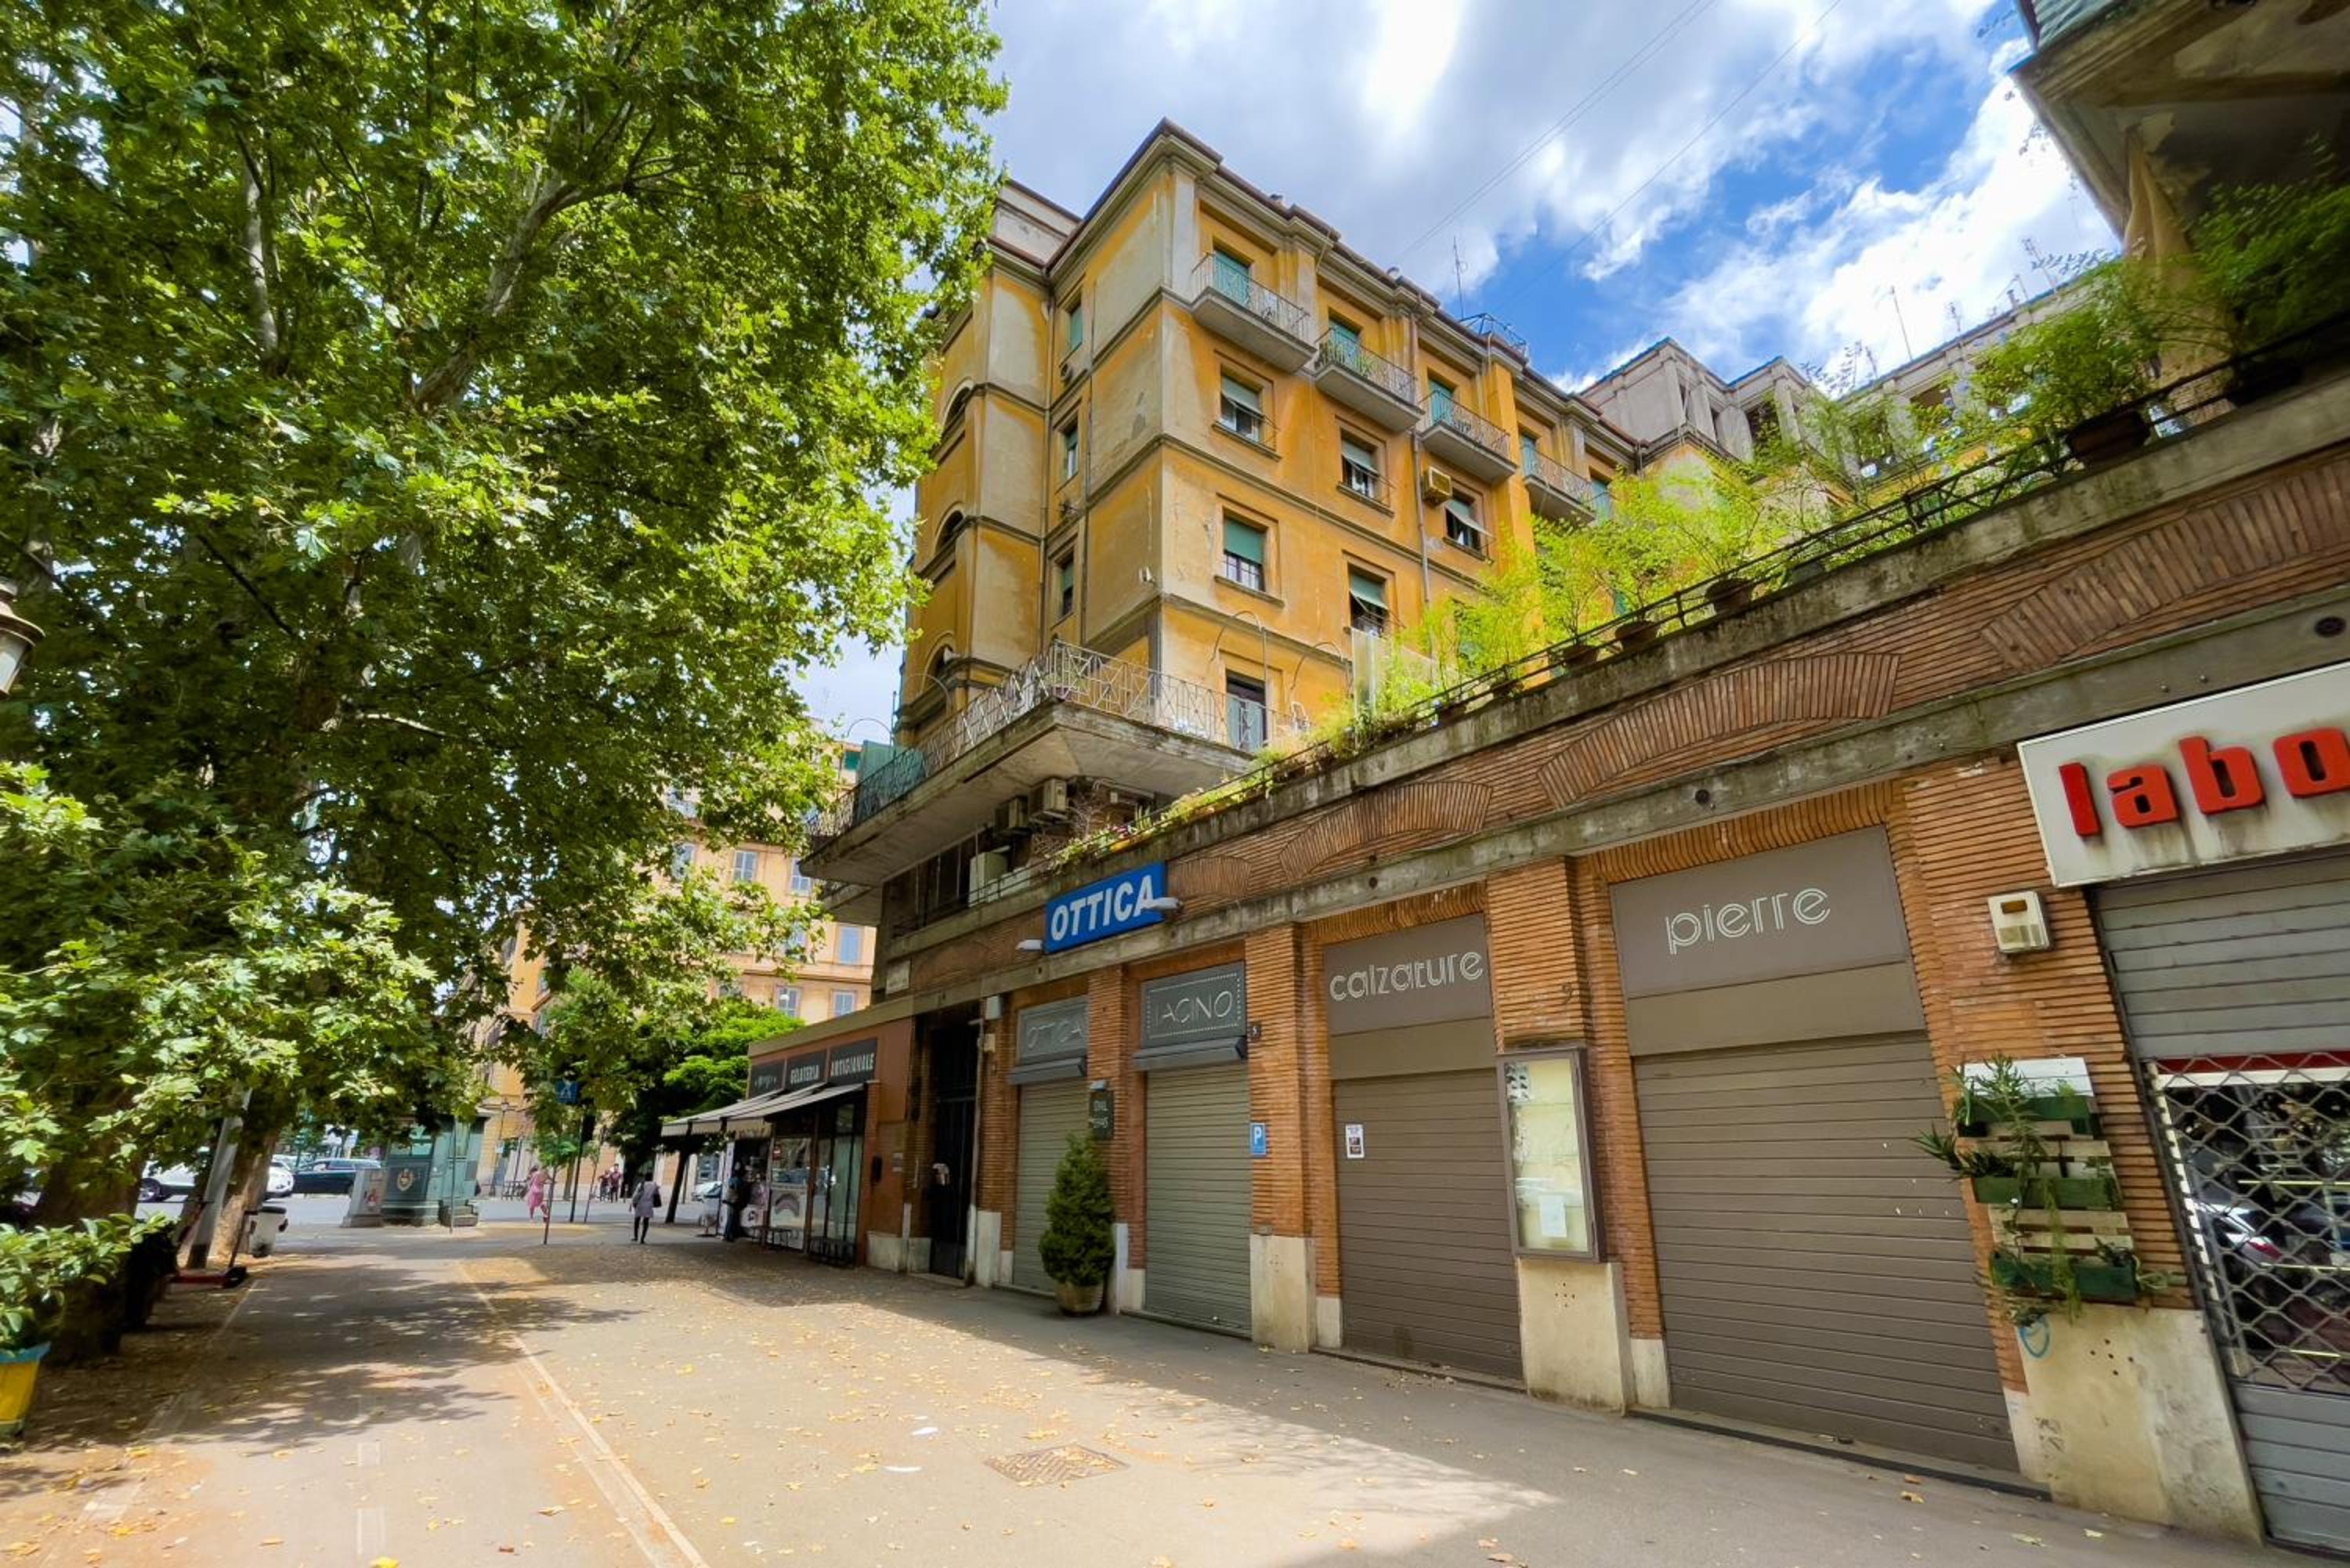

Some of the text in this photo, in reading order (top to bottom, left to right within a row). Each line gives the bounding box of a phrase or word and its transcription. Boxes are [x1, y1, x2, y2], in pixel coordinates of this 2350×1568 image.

[2058, 726, 2350, 837] labo
[1050, 874, 1156, 941] OTTICA
[1665, 887, 1831, 955] pierre
[1329, 951, 1483, 1001] calzature
[1253, 1126, 1262, 1145] P
